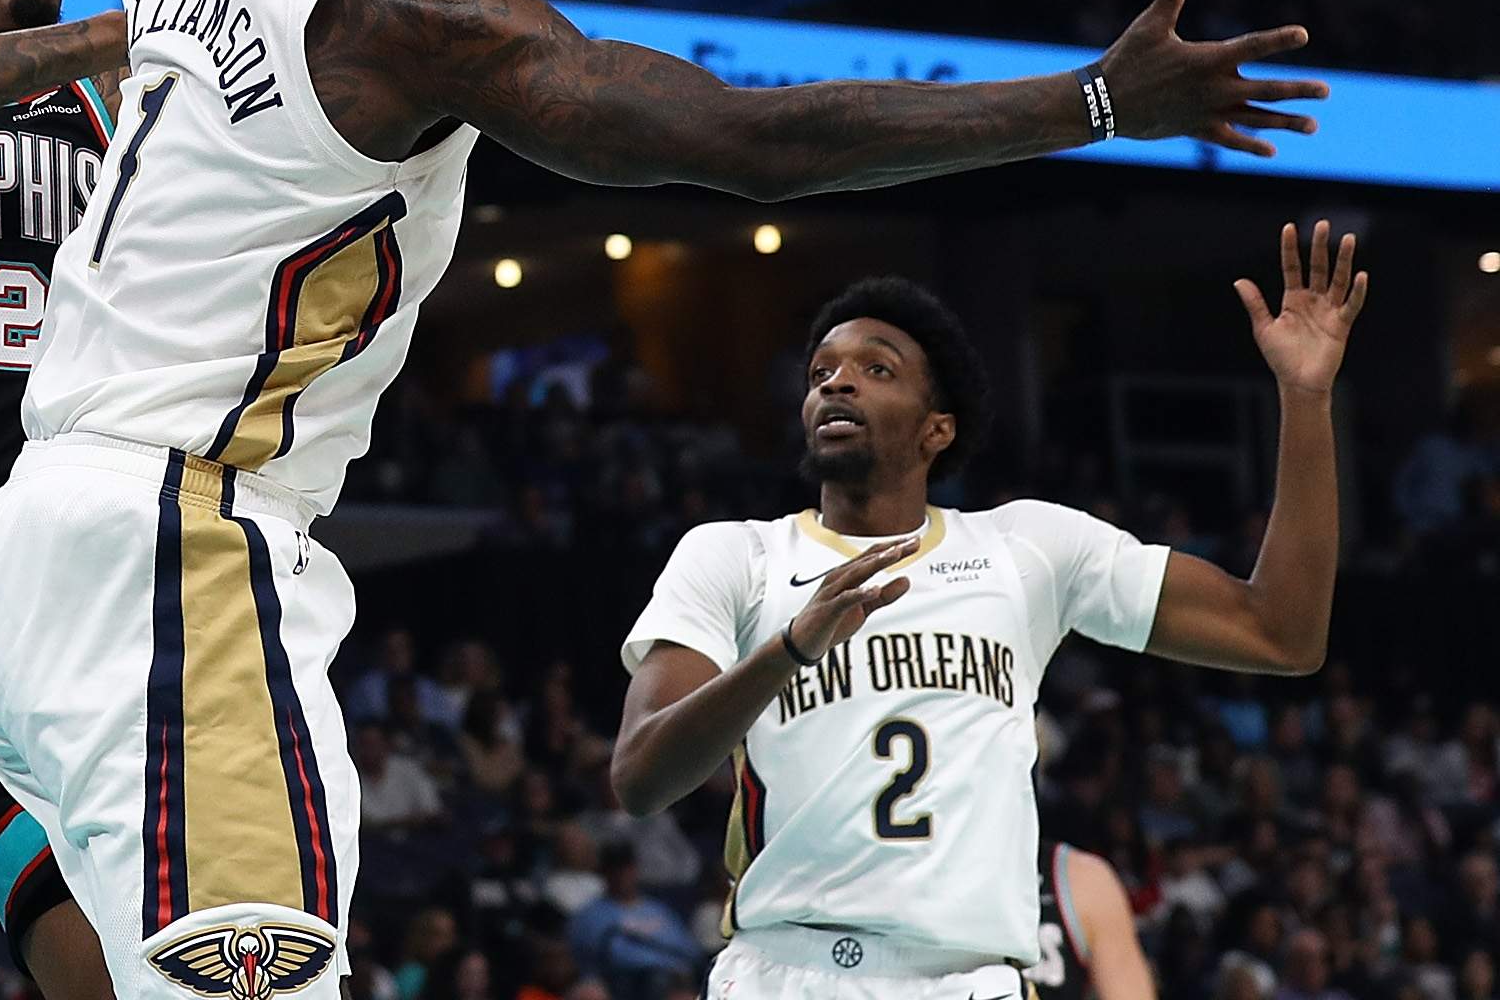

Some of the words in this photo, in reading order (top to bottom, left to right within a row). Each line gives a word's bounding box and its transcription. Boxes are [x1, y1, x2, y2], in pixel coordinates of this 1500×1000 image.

[12, 103, 82, 123] Robinhood
[88, 71, 181, 272] 1
[929, 557, 993, 575] NEWAGE
[779, 639, 852, 725] NEW
[866, 632, 1015, 710] ORLEANS
[871, 714, 935, 844] 2
